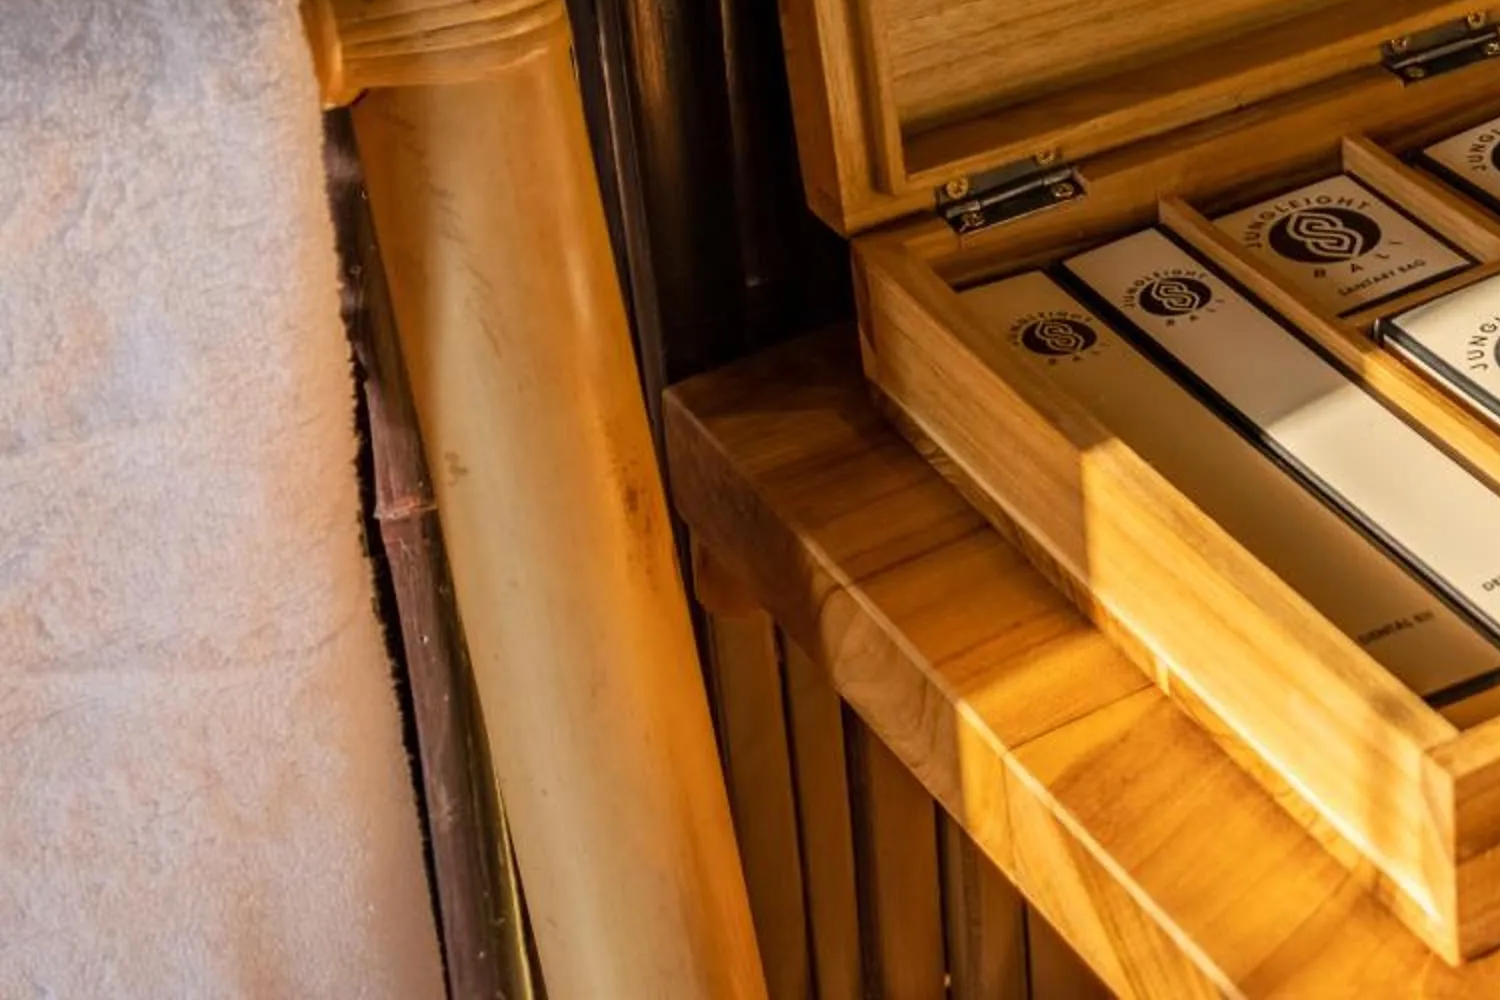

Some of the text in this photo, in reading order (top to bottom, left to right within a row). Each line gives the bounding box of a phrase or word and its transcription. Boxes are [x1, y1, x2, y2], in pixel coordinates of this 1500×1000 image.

[1243, 194, 1371, 249] JUNGLEIGHT
[1313, 240, 1403, 279] BALI
[1337, 259, 1426, 297] SANITARY BAG
